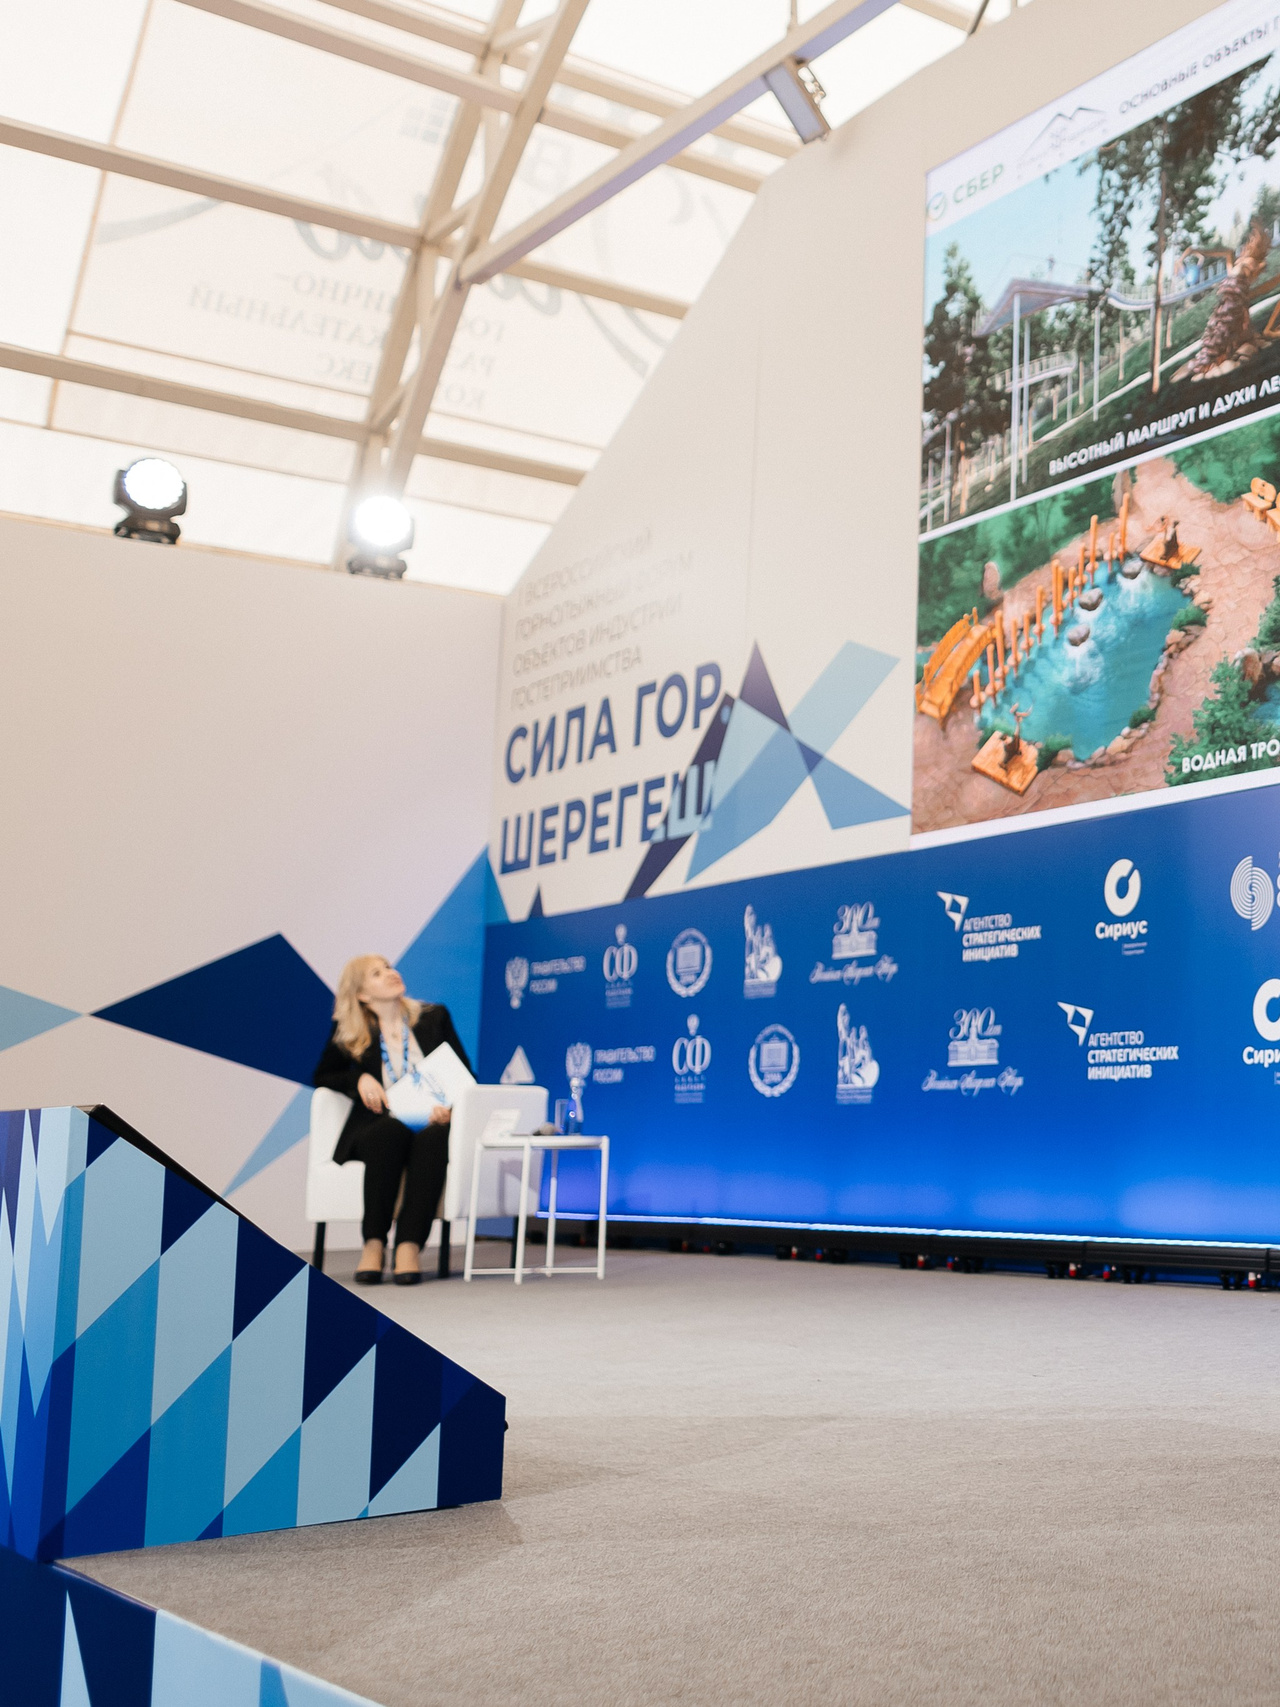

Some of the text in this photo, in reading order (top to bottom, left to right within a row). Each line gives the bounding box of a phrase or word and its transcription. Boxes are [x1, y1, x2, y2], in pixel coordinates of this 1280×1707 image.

[1119, 61, 1198, 115] ОСНОВНЫЕ
[1202, 21, 1269, 68] ОБЪЕКТЫ
[952, 163, 1004, 204] СБЕР
[1049, 431, 1125, 476] ВЫСОТНЫЙ
[1126, 406, 1197, 448] МАРШРУТ
[1198, 402, 1210, 420] И
[1211, 387, 1257, 417] ДУХИ
[504, 661, 722, 785] СИЛА ГОР
[1181, 745, 1248, 774] ВОДНАЯ
[499, 759, 717, 875] ШЕРЕГЕШ
[962, 913, 1012, 932] АГЕНТСТВО
[1095, 920, 1148, 942] Сириус
[961, 925, 1042, 948] СТРАТЕГИЧЕСКИХ
[962, 943, 1019, 963] ИНИЦИАТИВ
[1088, 1030, 1144, 1048] АГЕНТСТВО
[672, 1035, 712, 1076] СФ
[1087, 1046, 1179, 1064] СТРАТЕГИЧЕСКИХ
[1087, 1064, 1152, 1082] ИНИЦИАТИВ
